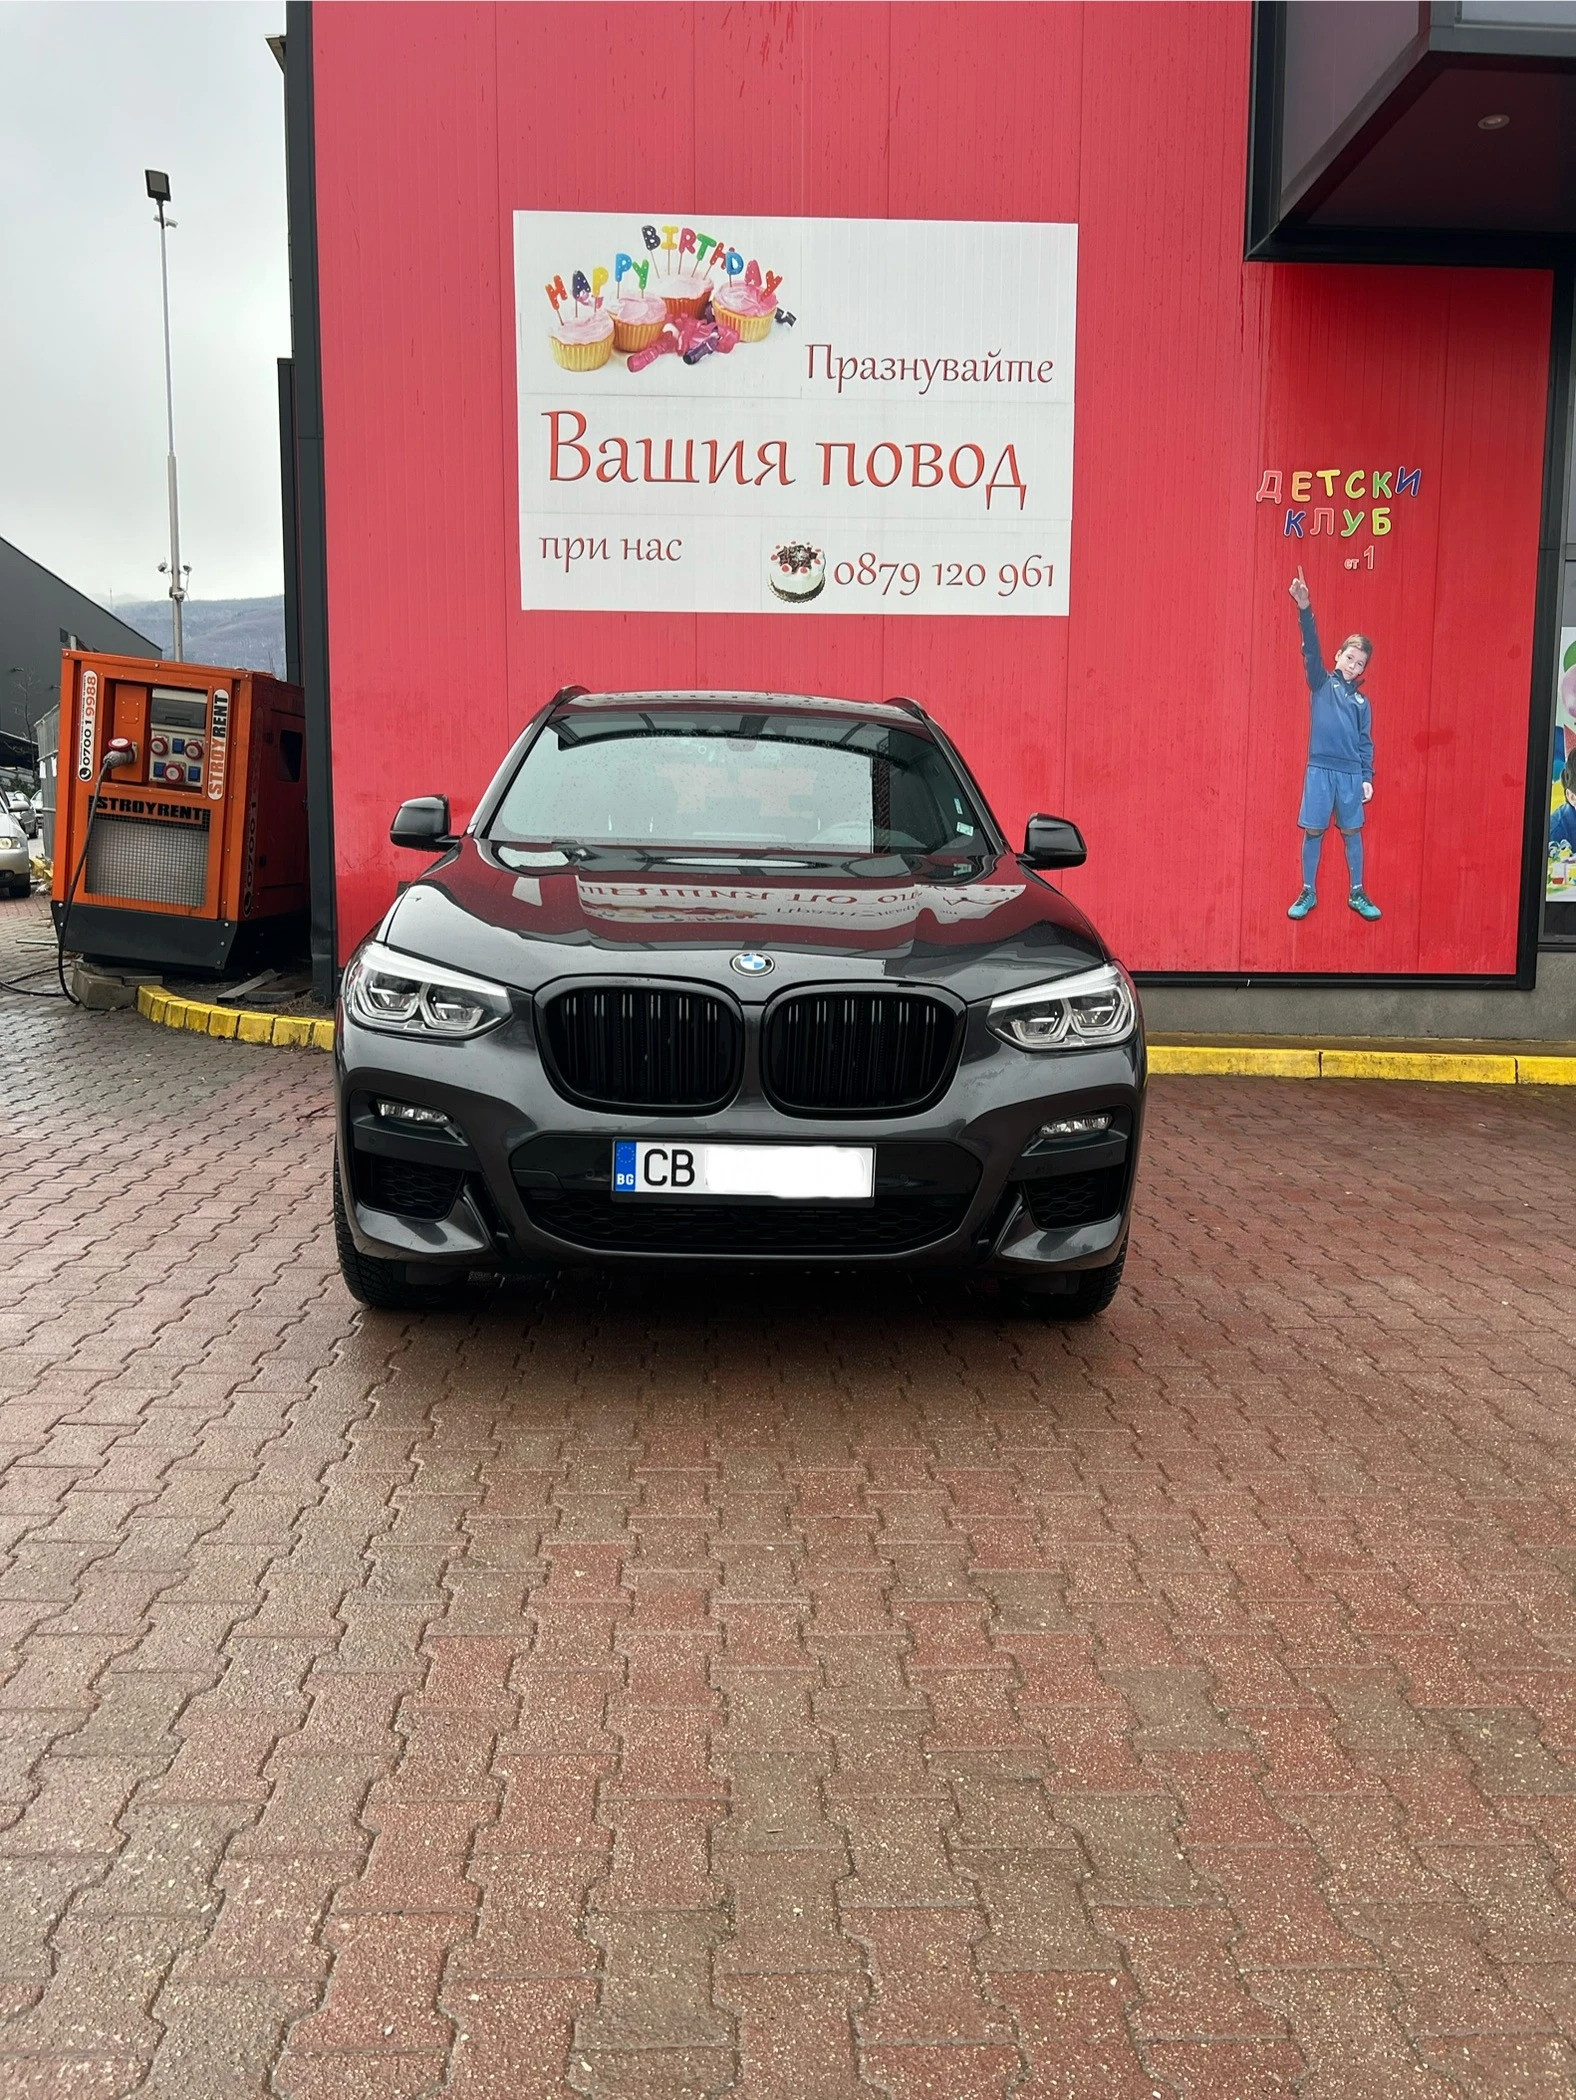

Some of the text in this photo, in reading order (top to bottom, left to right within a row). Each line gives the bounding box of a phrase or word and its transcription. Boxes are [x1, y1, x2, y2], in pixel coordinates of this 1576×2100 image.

[545, 225, 783, 310] HAPPY BIRTHDAY
[805, 344, 1054, 395] Празнувайте
[541, 410, 1027, 510] Вашия повод
[1256, 466, 1422, 504] ДЕТСКИ
[1283, 507, 1392, 538] КЛУБ
[539, 535, 683, 573] при нас
[1344, 545, 1375, 570] от 1
[834, 553, 1055, 596] 0879 120 961
[86, 676, 96, 717] 9988
[83, 729, 92, 766] 0700
[209, 694, 228, 794] STROYRENT
[96, 796, 203, 820] STROYRENT
[616, 1148, 696, 1187] BG CB
